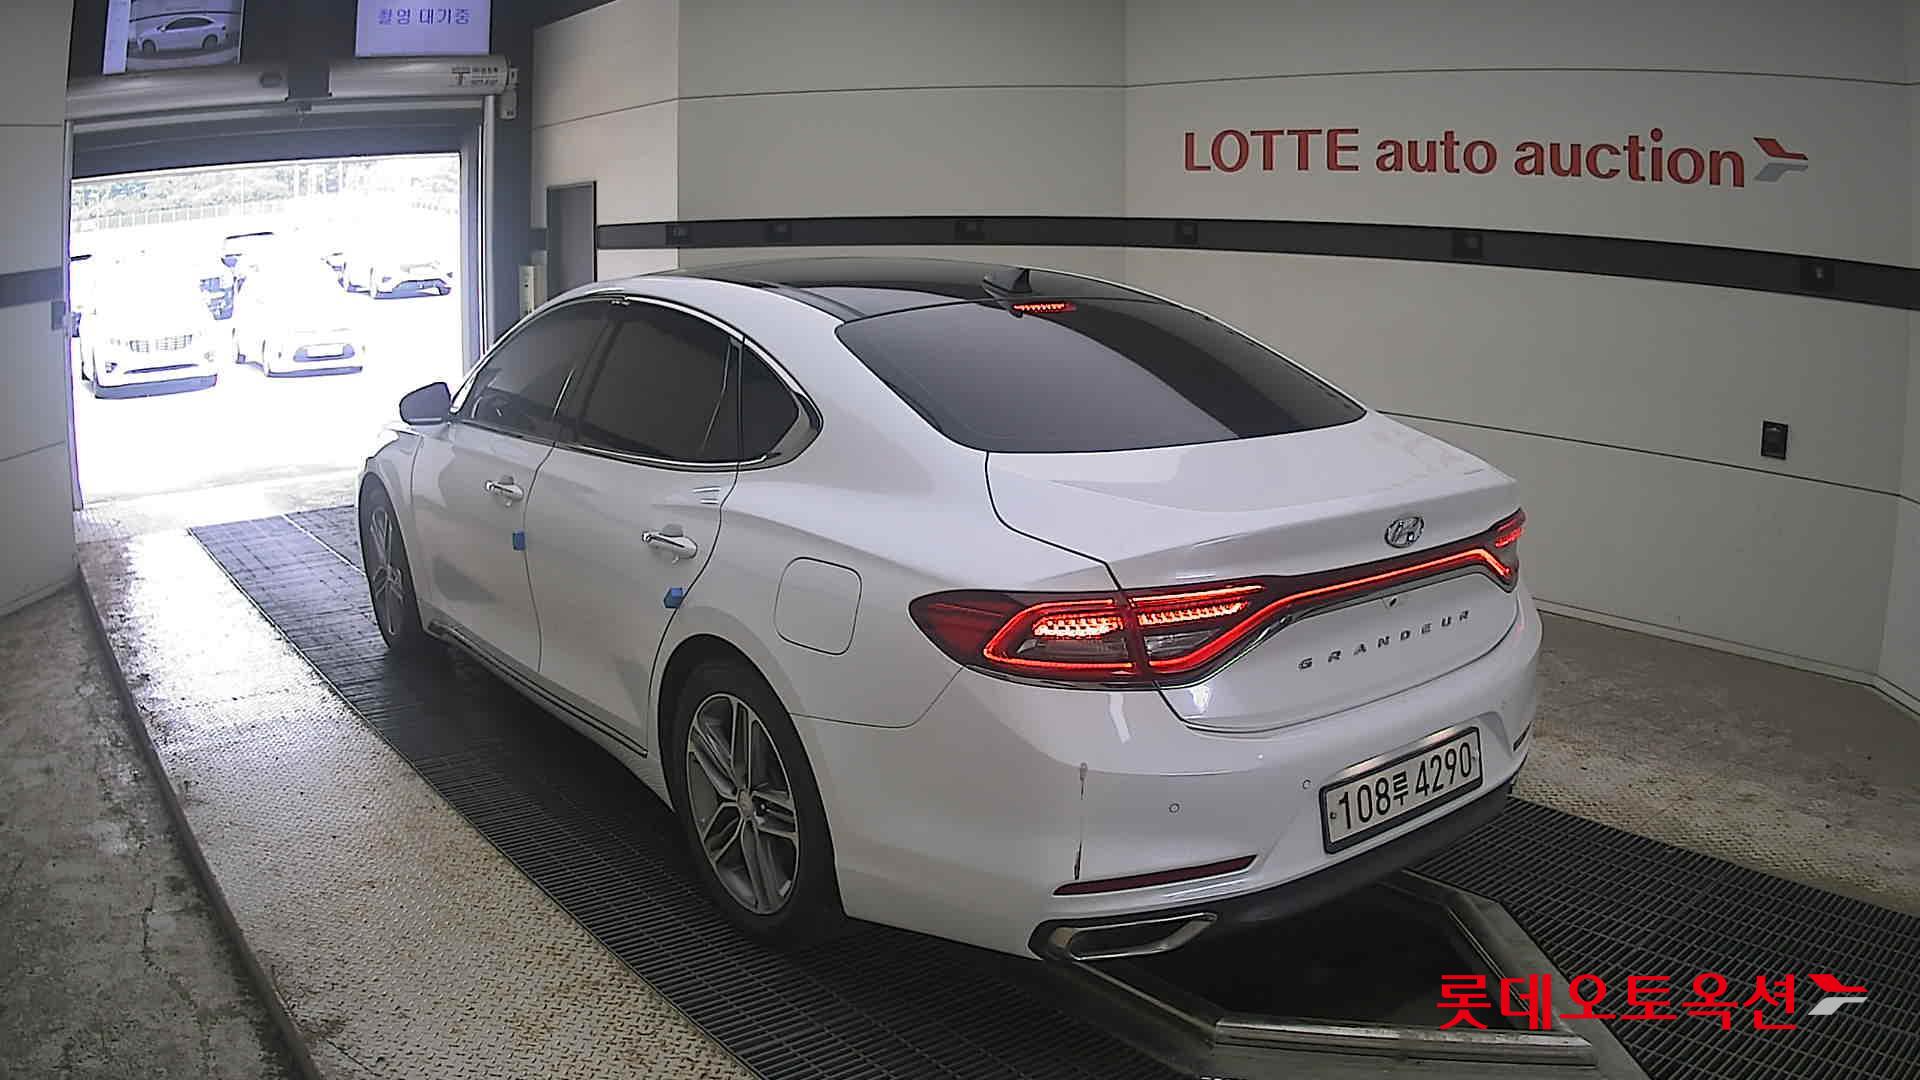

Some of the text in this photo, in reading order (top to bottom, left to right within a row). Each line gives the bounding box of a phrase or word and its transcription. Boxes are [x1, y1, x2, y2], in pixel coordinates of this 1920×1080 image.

[419, 8, 470, 25] 대기중
[1184, 128, 1745, 187] LOTTE auto auction
[1297, 609, 1470, 671] GRANDEUR
[1338, 742, 1473, 830] 108루 4290
